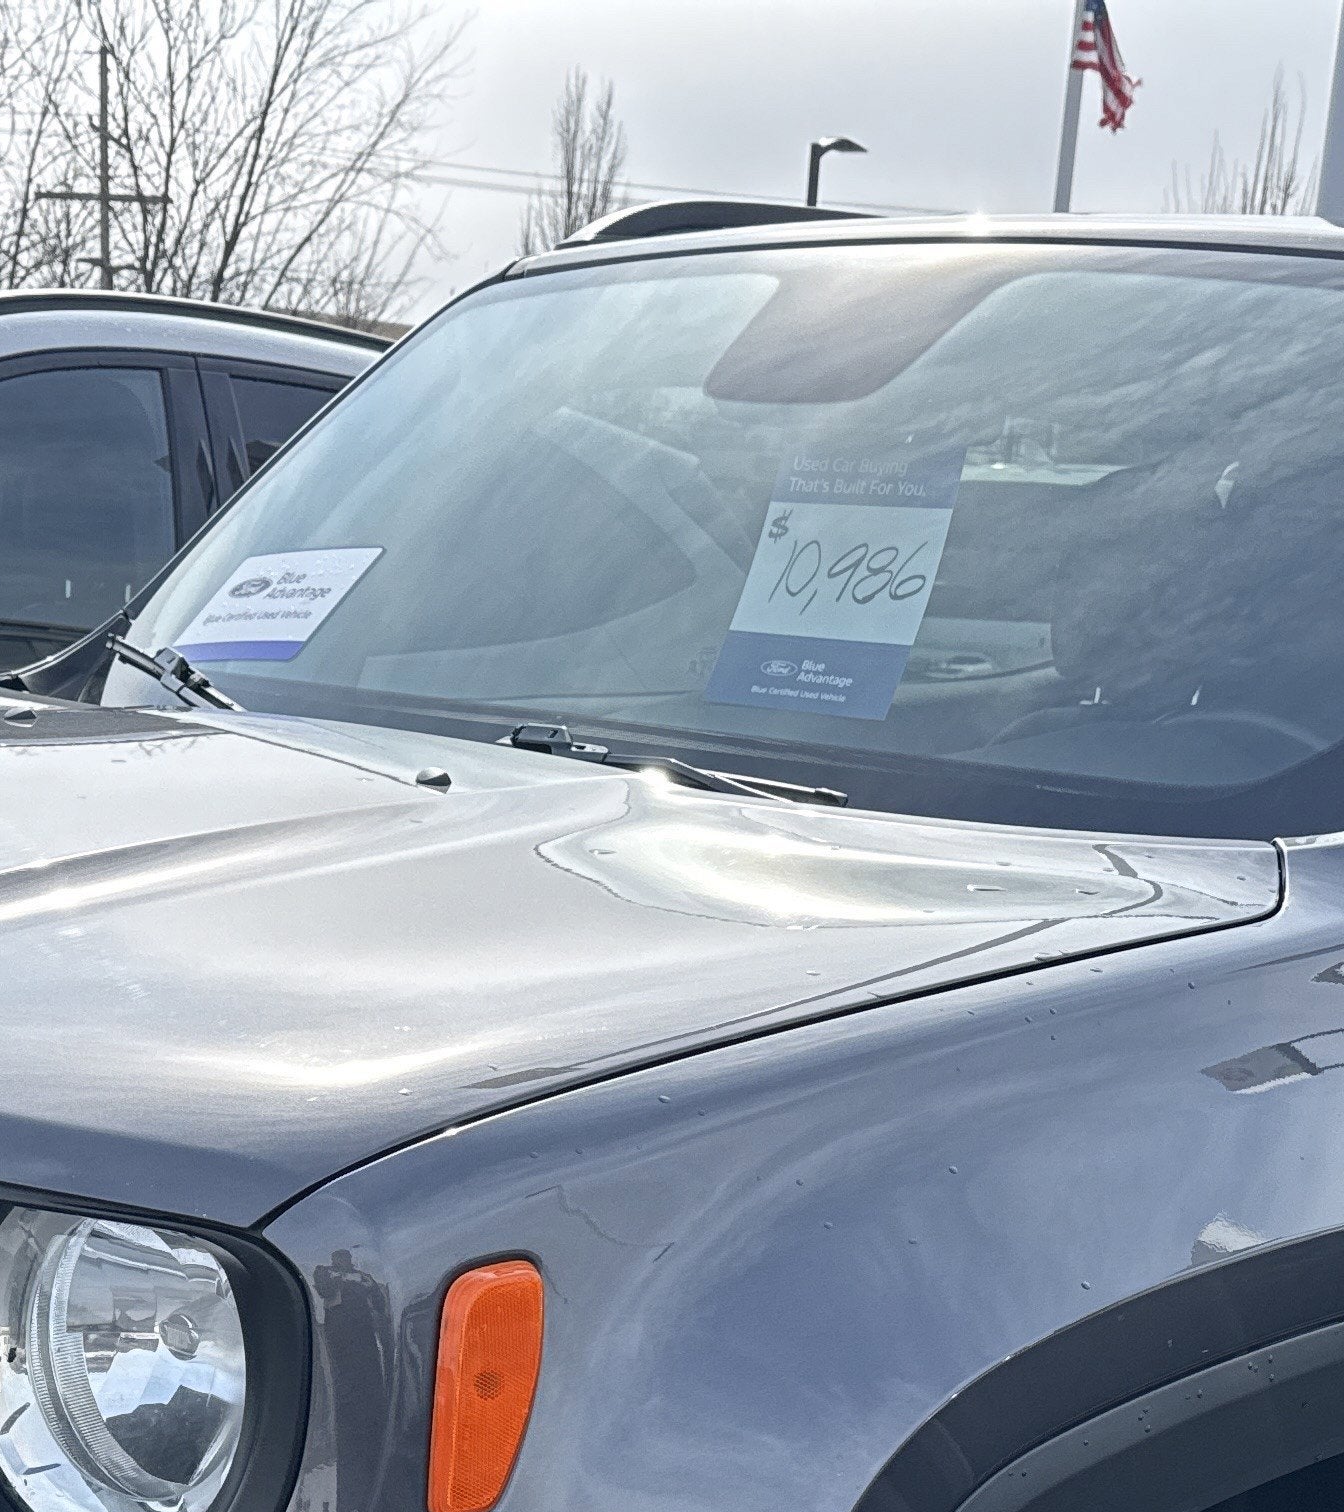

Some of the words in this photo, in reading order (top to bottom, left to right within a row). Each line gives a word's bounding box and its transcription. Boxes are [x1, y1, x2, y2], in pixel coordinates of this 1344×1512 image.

[793, 456, 829, 472] Used
[833, 458, 856, 473] Car
[859, 458, 908, 477] Buying
[788, 477, 830, 493] That's
[833, 479, 865, 494] Built
[869, 481, 893, 494] For
[768, 508, 794, 543] $
[768, 539, 929, 616] 10,986
[801, 659, 826, 672] Blue
[796, 672, 854, 688] Advantage
